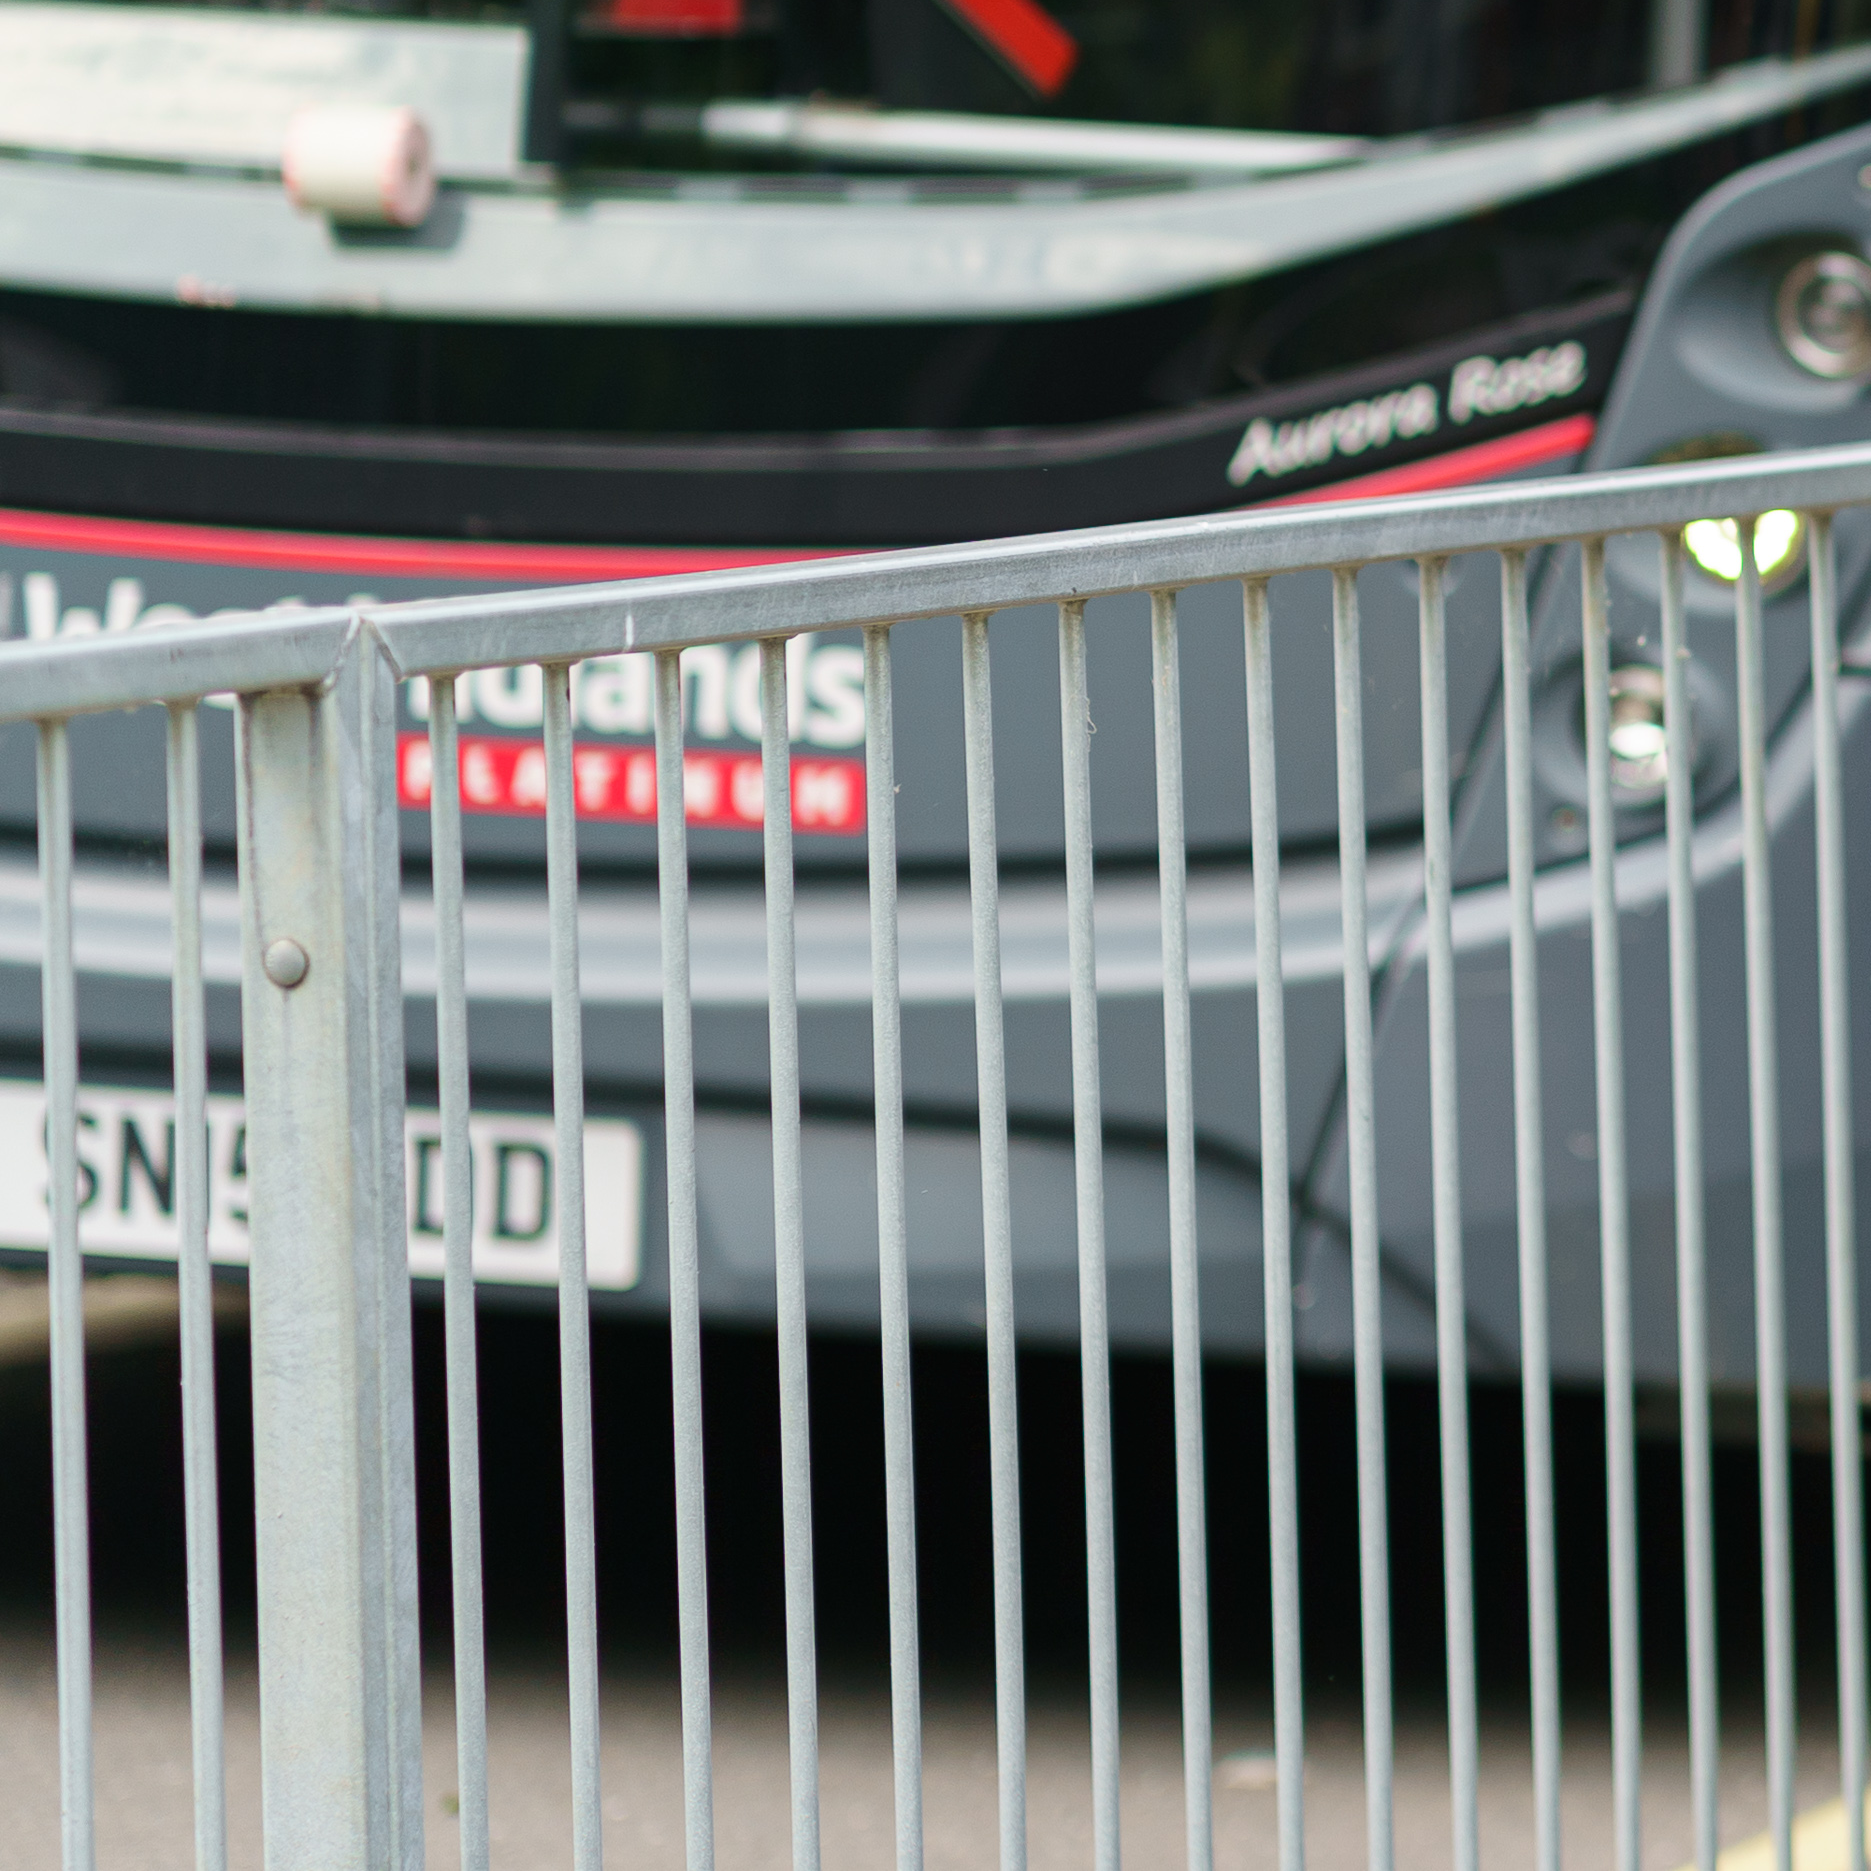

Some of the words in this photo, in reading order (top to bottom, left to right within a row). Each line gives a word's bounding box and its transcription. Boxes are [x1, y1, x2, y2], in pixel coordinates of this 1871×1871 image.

[1226, 383, 1438, 487] Aurora
[1448, 340, 1588, 424] Rose
[44, 1110, 250, 1224] SN
